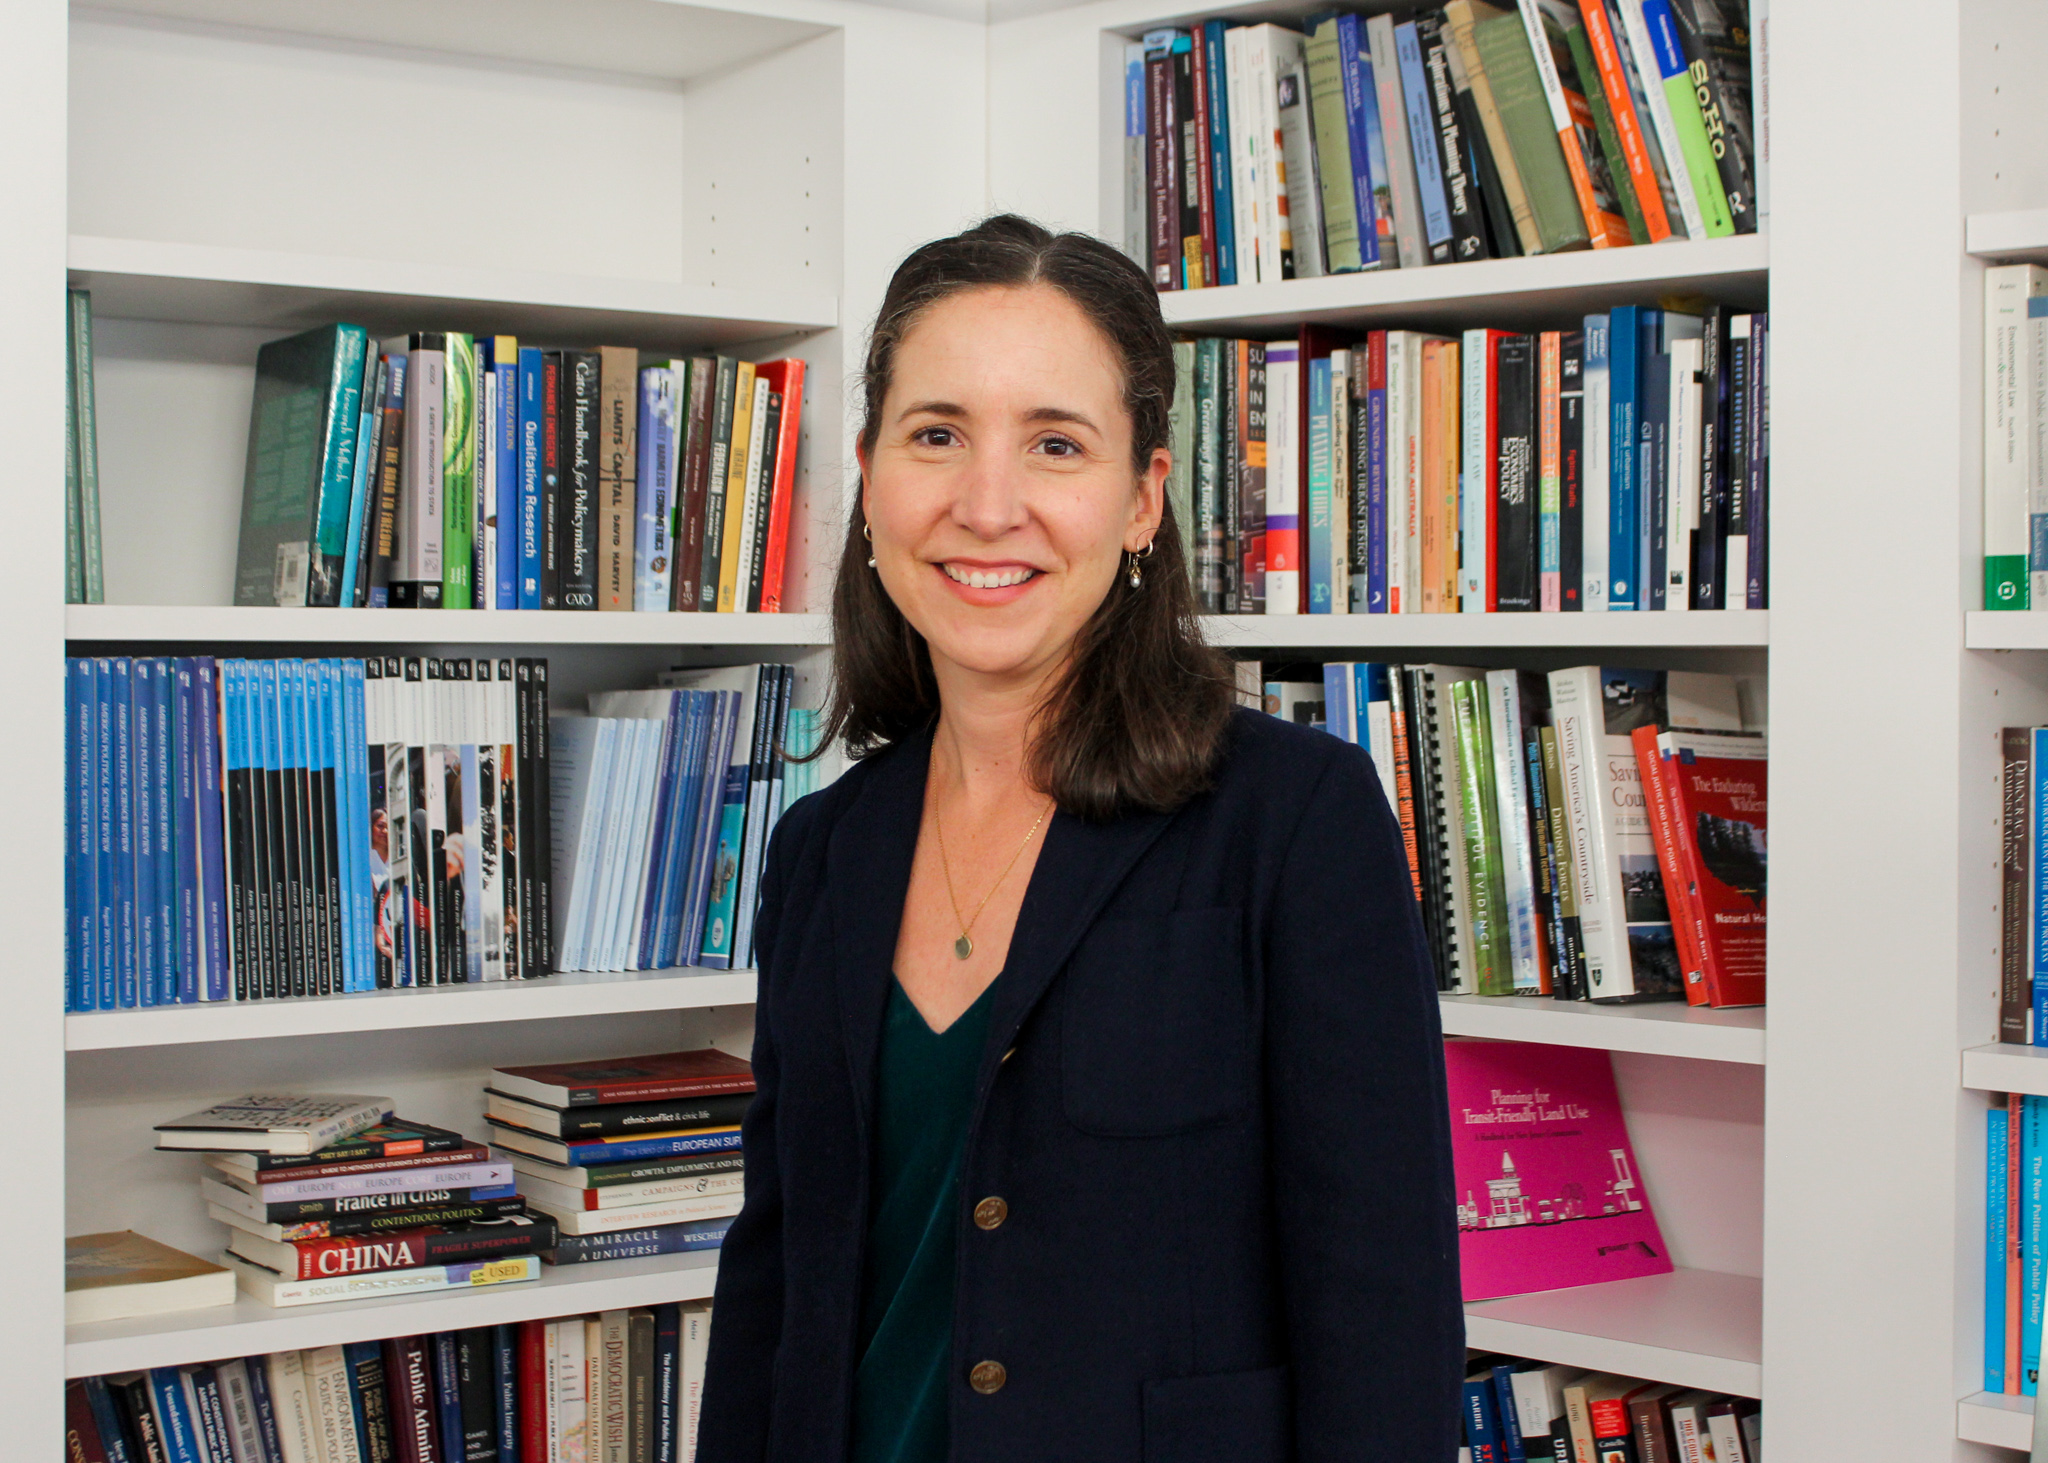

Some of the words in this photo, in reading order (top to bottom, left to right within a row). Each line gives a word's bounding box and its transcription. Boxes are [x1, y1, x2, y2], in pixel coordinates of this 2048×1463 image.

[1426, 45, 1451, 113] Explorations
[1153, 63, 1166, 136] Infrastructure
[1688, 59, 1726, 160] SoHo
[1440, 112, 1455, 127] in
[1153, 139, 1166, 186] Planning
[1442, 124, 1461, 177] Planning
[1452, 174, 1468, 215] Theory
[1157, 189, 1167, 246] Handbook
[1391, 362, 1399, 386] Design
[1472, 336, 1481, 406] BICYCLING
[1544, 351, 1556, 389] NEW
[1735, 345, 1743, 386] ROBERT
[2007, 326, 2018, 388] Environmental
[546, 365, 556, 416] PERMANENT
[575, 363, 588, 396] Cato
[1335, 386, 1343, 401] The
[506, 369, 514, 450] PRIVATIZATION
[2008, 391, 2017, 408] Law
[2033, 390, 2045, 418] Public
[575, 399, 588, 467] Handbook
[613, 400, 623, 445] LIMITS
[1199, 398, 1214, 459] Greenways
[1333, 403, 1343, 446] Exploding
[1357, 406, 1367, 470] ASSESSING
[1372, 396, 1380, 449] GROUNDS
[1472, 424, 1481, 451] THE
[1544, 392, 1556, 459] TRANSIT
[1622, 403, 1633, 447] splintering
[385, 446, 399, 463] THE
[524, 421, 537, 492] Qualitative
[546, 417, 556, 468] EMERGENCY
[1372, 450, 1380, 462] for
[1703, 424, 1714, 460] Mobility
[2035, 420, 2047, 486] Administration
[572, 469, 587, 488] for
[612, 452, 623, 505] CAPITAL
[711, 442, 727, 494] FEDERALISM
[731, 447, 744, 479] UKRAINE
[1200, 462, 1214, 480] for
[1335, 449, 1344, 474] Cities
[1472, 454, 1481, 482] LAW
[1499, 456, 1510, 499] POLICY
[1509, 437, 1519, 505] ECONOMICS
[1518, 436, 1528, 503] TRANSPORTATION
[1567, 449, 1576, 482] Fighting
[1624, 450, 1633, 489] urbanism
[1704, 461, 1713, 470] in
[383, 467, 396, 494] ROAD
[1357, 473, 1366, 516] URBAN
[1372, 464, 1380, 504] REVIEW
[1543, 464, 1556, 508] TOWN
[1569, 483, 1577, 508] Traffic
[1703, 472, 1713, 495] Daily
[382, 496, 395, 509] TO
[1201, 481, 1214, 531] America
[1704, 497, 1713, 513] Life
[1732, 479, 1742, 520] SPRAWL
[378, 512, 393, 557] FREEDOM
[525, 495, 537, 558] Research
[571, 489, 588, 576] Policymakers
[612, 515, 620, 546] DAVID
[1356, 520, 1366, 565] DESIGN
[612, 552, 620, 592] HARVEY
[80, 703, 89, 744] AMERICAN
[1391, 711, 1407, 736] DREAM
[1563, 716, 1575, 758] Saving
[81, 746, 89, 787] POLITICAL
[1528, 742, 1541, 760] Public
[1647, 750, 1656, 774] SOCIAL
[1530, 762, 1543, 808] Administration
[1568, 761, 1584, 825] America's
[1652, 776, 1662, 805] JUSTICE
[1692, 775, 1713, 792] The
[1712, 777, 1757, 797] Enduring
[2014, 760, 2028, 841] DEMOCRACY
[81, 789, 89, 822] SCIENCE
[1466, 777, 1483, 863] BEAUTIFUL
[1546, 741, 1555, 770] DUNN
[1552, 807, 1564, 857] DRIVING
[1558, 859, 1569, 902] FORCES
[1657, 808, 1666, 826] AND
[81, 824, 89, 854] REVIEW
[1535, 820, 1548, 856] Information
[1660, 827, 1670, 849] PUBLIC
[1538, 857, 1551, 894] Technology
[1576, 826, 1594, 905] Countryside
[1664, 850, 1676, 873] POLICY
[1474, 873, 1490, 951] EVIDENCE
[1715, 912, 1750, 925] Natural
[1463, 1106, 1537, 1125] Transit-Friendly
[1538, 1106, 1565, 1121] Land
[1567, 1104, 1589, 1119] Use
[1491, 1089, 1534, 1108] Planning
[1534, 1087, 1550, 1103] for
[672, 1139, 722, 1152] EUROPEAN
[297, 1181, 336, 1194] EUROPE
[365, 1175, 402, 1187] EUROPE
[435, 1171, 471, 1183] EUROPE
[2031, 1156, 2042, 1175] The
[299, 1202, 324, 1214] Smith
[335, 1193, 387, 1212] France
[642, 1184, 695, 1196] CAMPAIGNS
[710, 1179, 728, 1188] THE
[2032, 1178, 2041, 1199] New
[371, 1213, 440, 1228] CONTENTIOUS
[442, 1207, 484, 1220] POLITICS
[2031, 1204, 2042, 1241] Politics
[432, 1242, 469, 1255] FRAGILE
[471, 1235, 531, 1249] SUPERPOWER
[579, 1239, 589, 1248] A
[593, 1230, 659, 1246] MIRACLE
[579, 1252, 588, 1261] A
[592, 1244, 659, 1260] UNIVERSE
[2032, 1244, 2041, 1255] of
[318, 1241, 415, 1275] CHINA
[489, 1265, 520, 1278] USED
[2031, 1258, 2041, 1290] Public
[2030, 1293, 2041, 1325] Policy
[609, 1326, 620, 1340] THE
[690, 1320, 698, 1340] Meier
[408, 1350, 427, 1405] Public
[502, 1348, 512, 1374] Dobel
[591, 1356, 599, 1378] DATA
[606, 1340, 624, 1410] DEMOCRATIC
[207, 1382, 217, 1398] THE
[318, 1377, 335, 1415] POLITICS
[503, 1382, 513, 1409] Public
[636, 1376, 645, 1400] INSIDE
[660, 1367, 670, 1404] Presidency
[139, 1413, 153, 1441] Public
[164, 1385, 186, 1447] Foundations
[179, 1448, 190, 1459] of
[198, 1386, 212, 1425] AMERICAN
[205, 1426, 217, 1450] PUBLIC
[210, 1399, 230, 1457] CONSTITUTIONAL
[325, 1418, 338, 1438] AND
[607, 1411, 624, 1442] WISH
[662, 1405, 670, 1418] and
[688, 1400, 699, 1434] Politics
[1471, 1395, 1484, 1431] BARBER
[1570, 1403, 1580, 1422] FUNG
[1683, 1419, 1694, 1436] THIS
[504, 1411, 514, 1450] Integrity
[662, 1419, 670, 1440] Public
[660, 1441, 669, 1462] Policy
